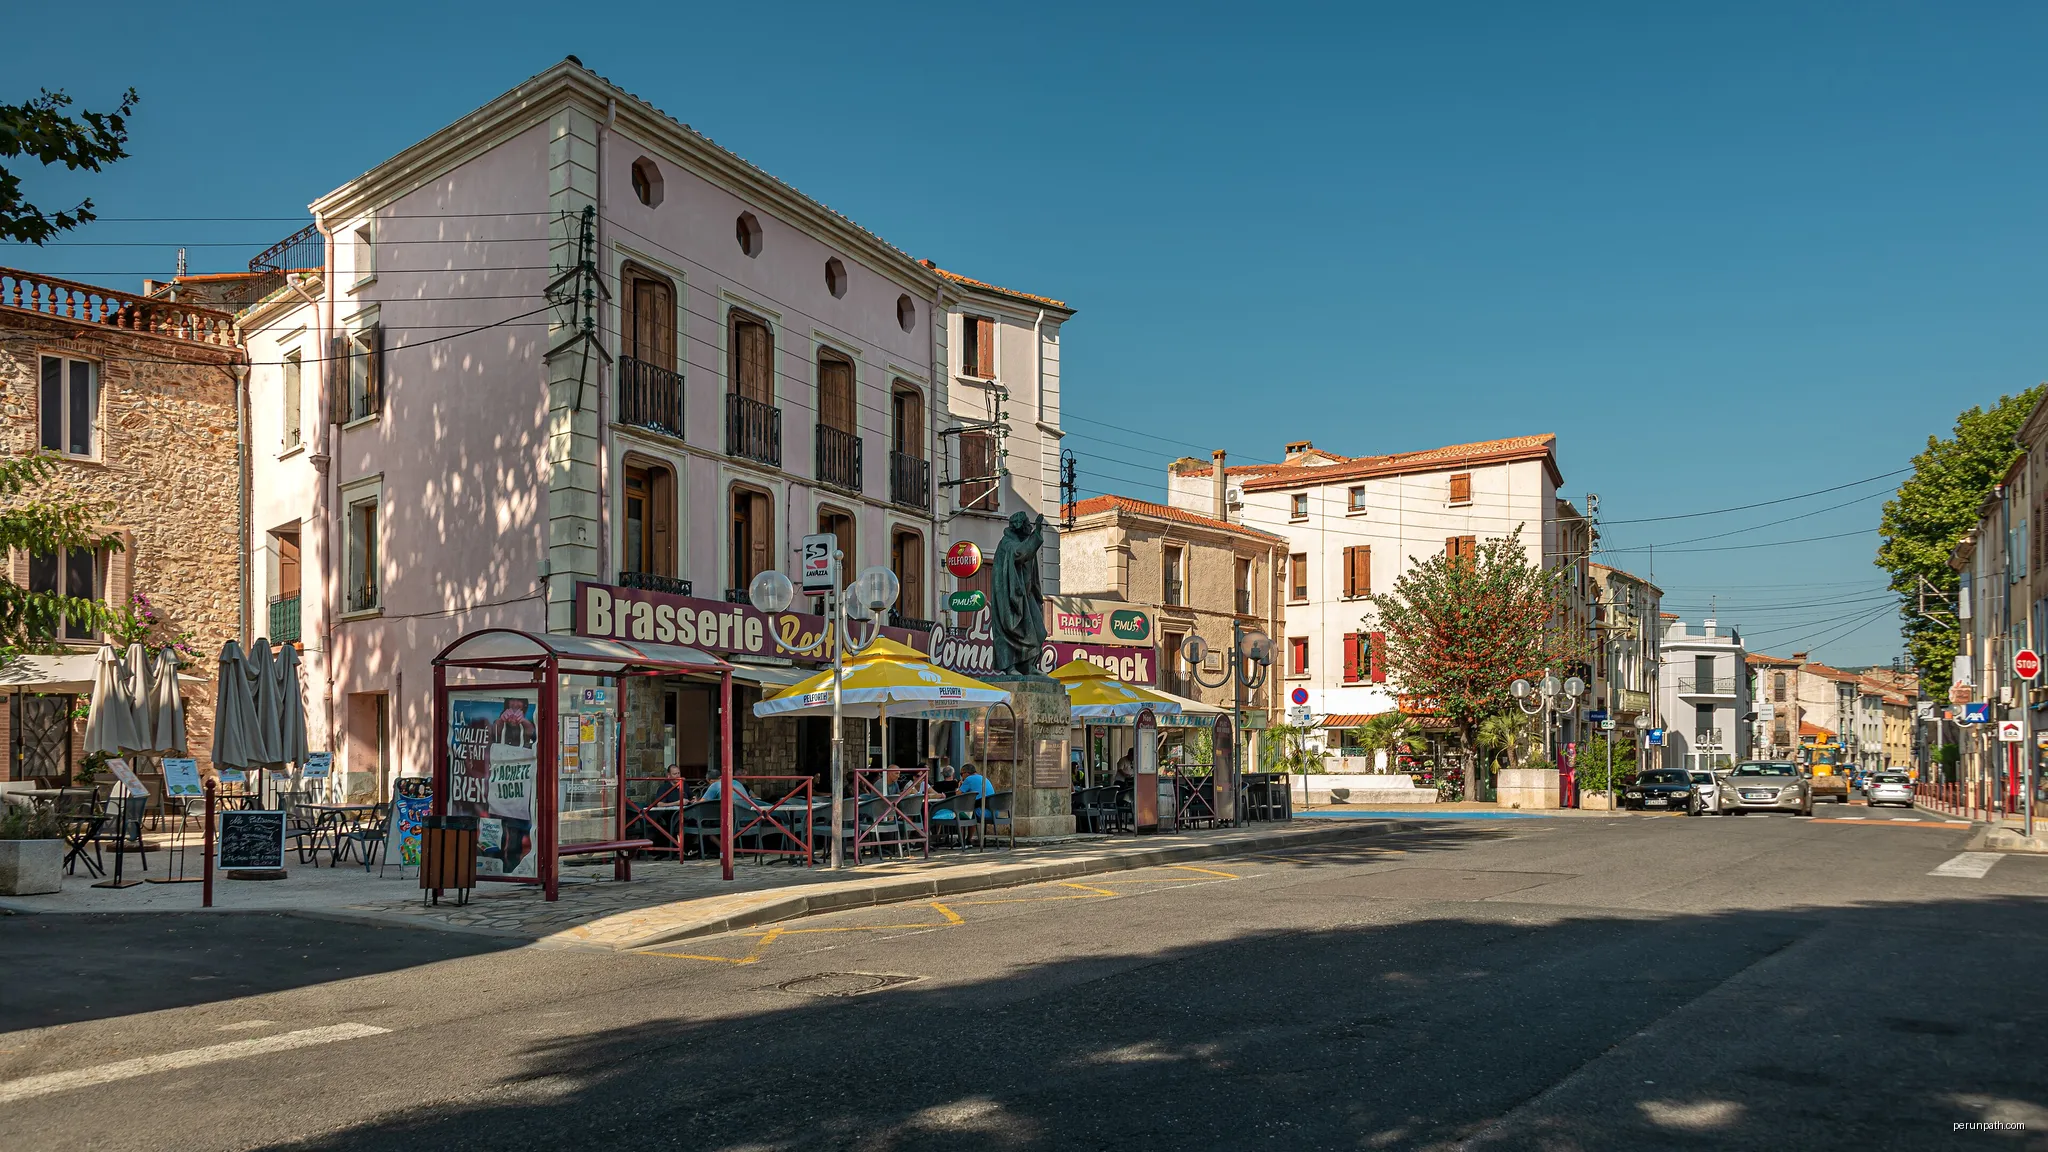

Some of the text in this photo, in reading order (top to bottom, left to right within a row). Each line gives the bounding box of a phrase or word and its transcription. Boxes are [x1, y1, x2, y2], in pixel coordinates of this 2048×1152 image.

[948, 555, 977, 566] PELFORTH
[806, 569, 828, 577] LAVAZZA
[951, 598, 969, 606] PMU
[586, 586, 763, 652] Brasserie
[969, 604, 994, 641] L
[1060, 615, 1098, 629] RAPIDO
[1113, 619, 1132, 631] PMU
[2016, 659, 2038, 669] STOP
[586, 690, 604, 699] 9 17
[803, 691, 828, 703] PELFORTH
[939, 687, 962, 696] PELFORTH
[454, 710, 466, 726] LA
[1965, 712, 1985, 721] AXA
[454, 726, 489, 745] QUALITÉ
[453, 744, 487, 761] ME FAIT
[453, 760, 467, 776] DU
[491, 763, 532, 783] J'ACHÈTE
[453, 776, 487, 803] BIEN
[497, 782, 525, 799] LOCAL
